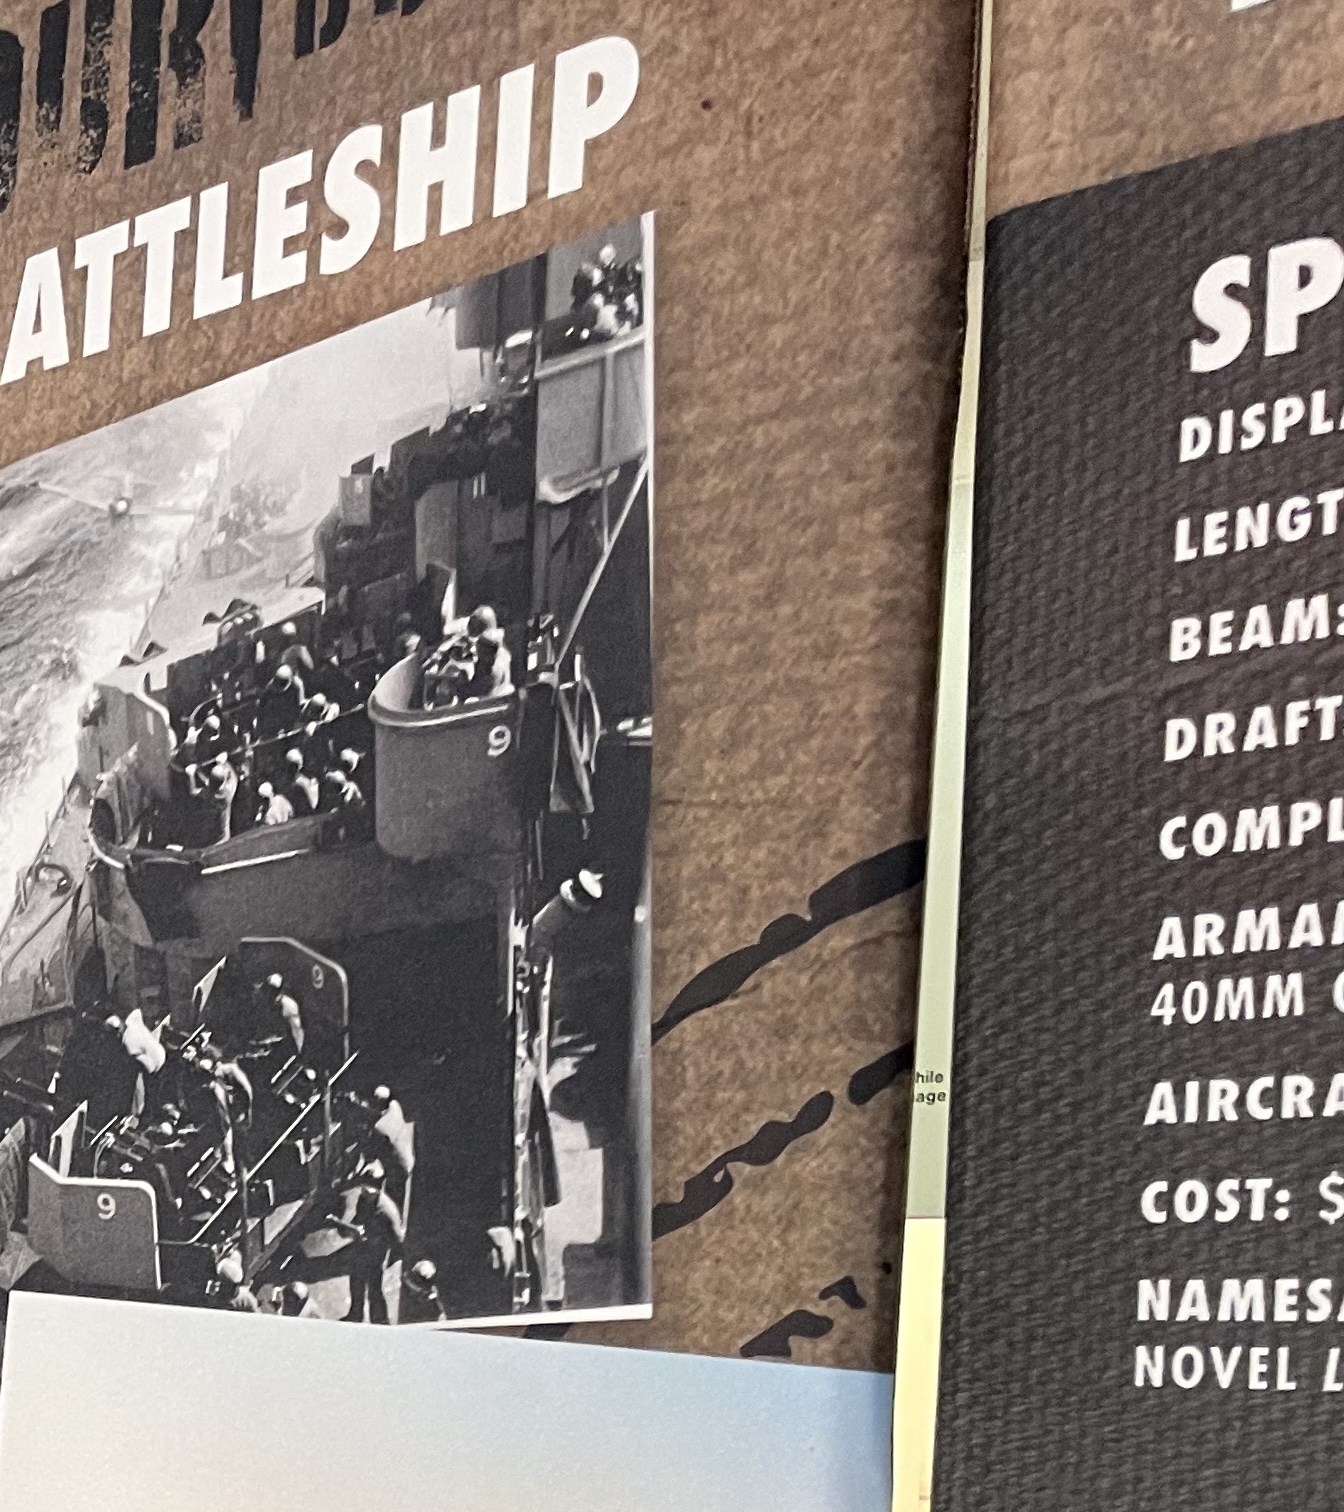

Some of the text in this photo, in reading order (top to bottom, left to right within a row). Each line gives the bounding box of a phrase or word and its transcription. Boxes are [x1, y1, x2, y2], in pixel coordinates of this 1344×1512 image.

[1190, 237, 1344, 373] SP
[1180, 389, 1344, 462] DISPL
[1175, 489, 1344, 562] LENGT
[487, 725, 511, 757] 9
[1164, 695, 1344, 762] DRAFT
[1159, 798, 1344, 860] COMPL
[1152, 902, 1344, 961] ARMA
[1151, 972, 1304, 1025] 40MM
[97, 1193, 116, 1220] 9
[1140, 1178, 1290, 1224] COST:
[1136, 1278, 1344, 1322] NAMES
[1134, 1345, 1297, 1391] NOVEL
